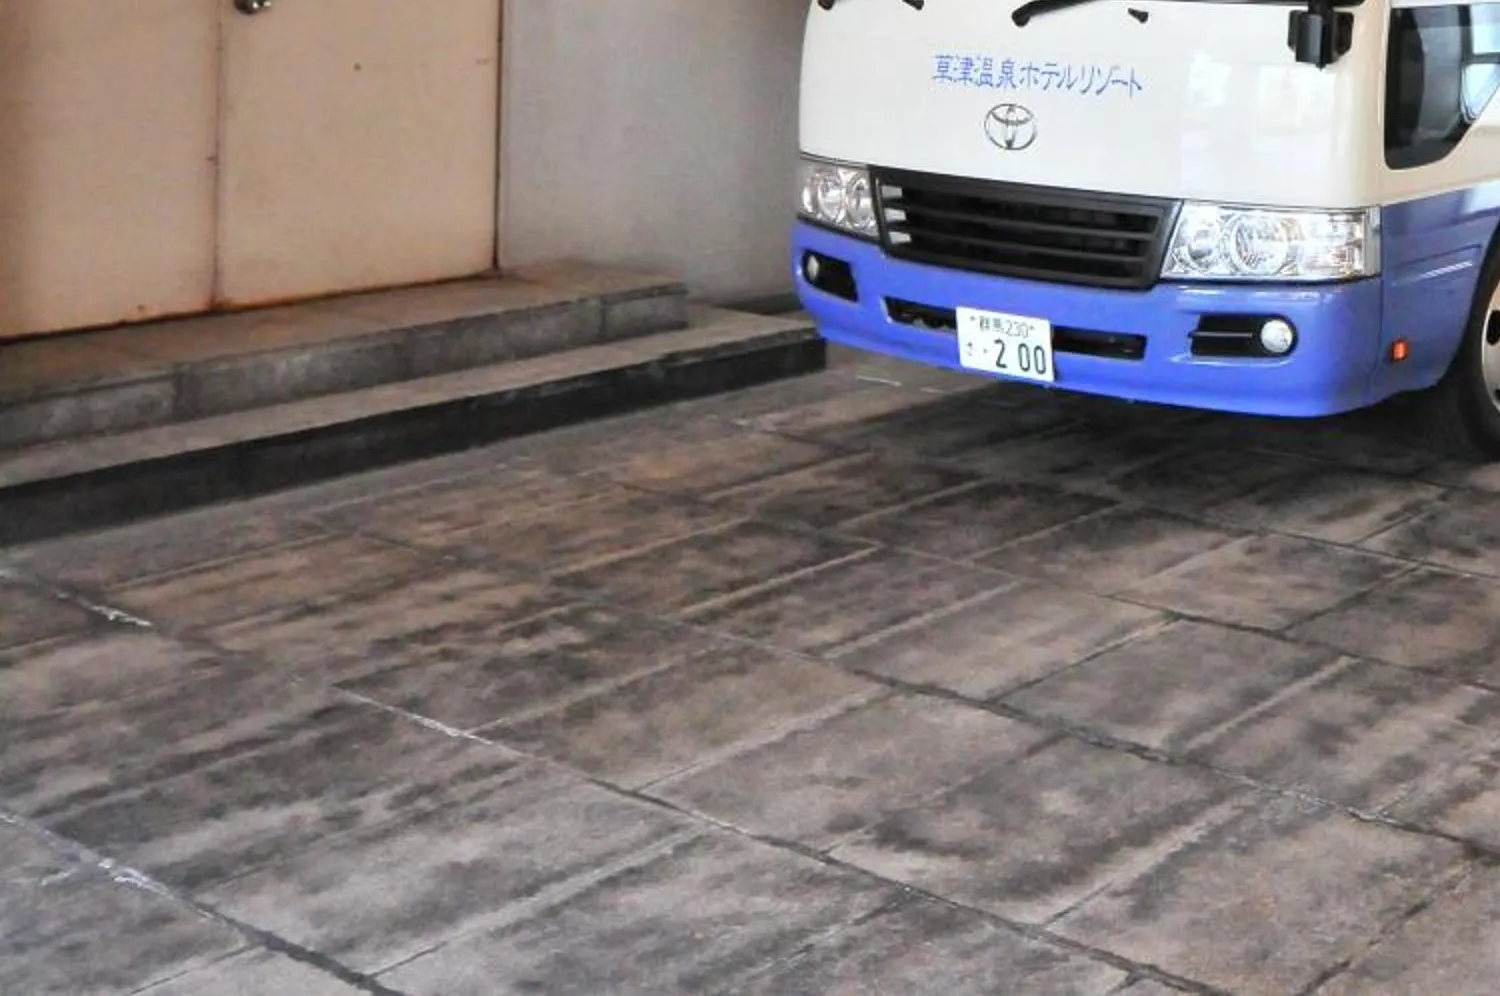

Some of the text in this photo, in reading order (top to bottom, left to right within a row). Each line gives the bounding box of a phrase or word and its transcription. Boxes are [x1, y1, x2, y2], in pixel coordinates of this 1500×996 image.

[932, 54, 1142, 98] 草津温泉ホテルリゾート
